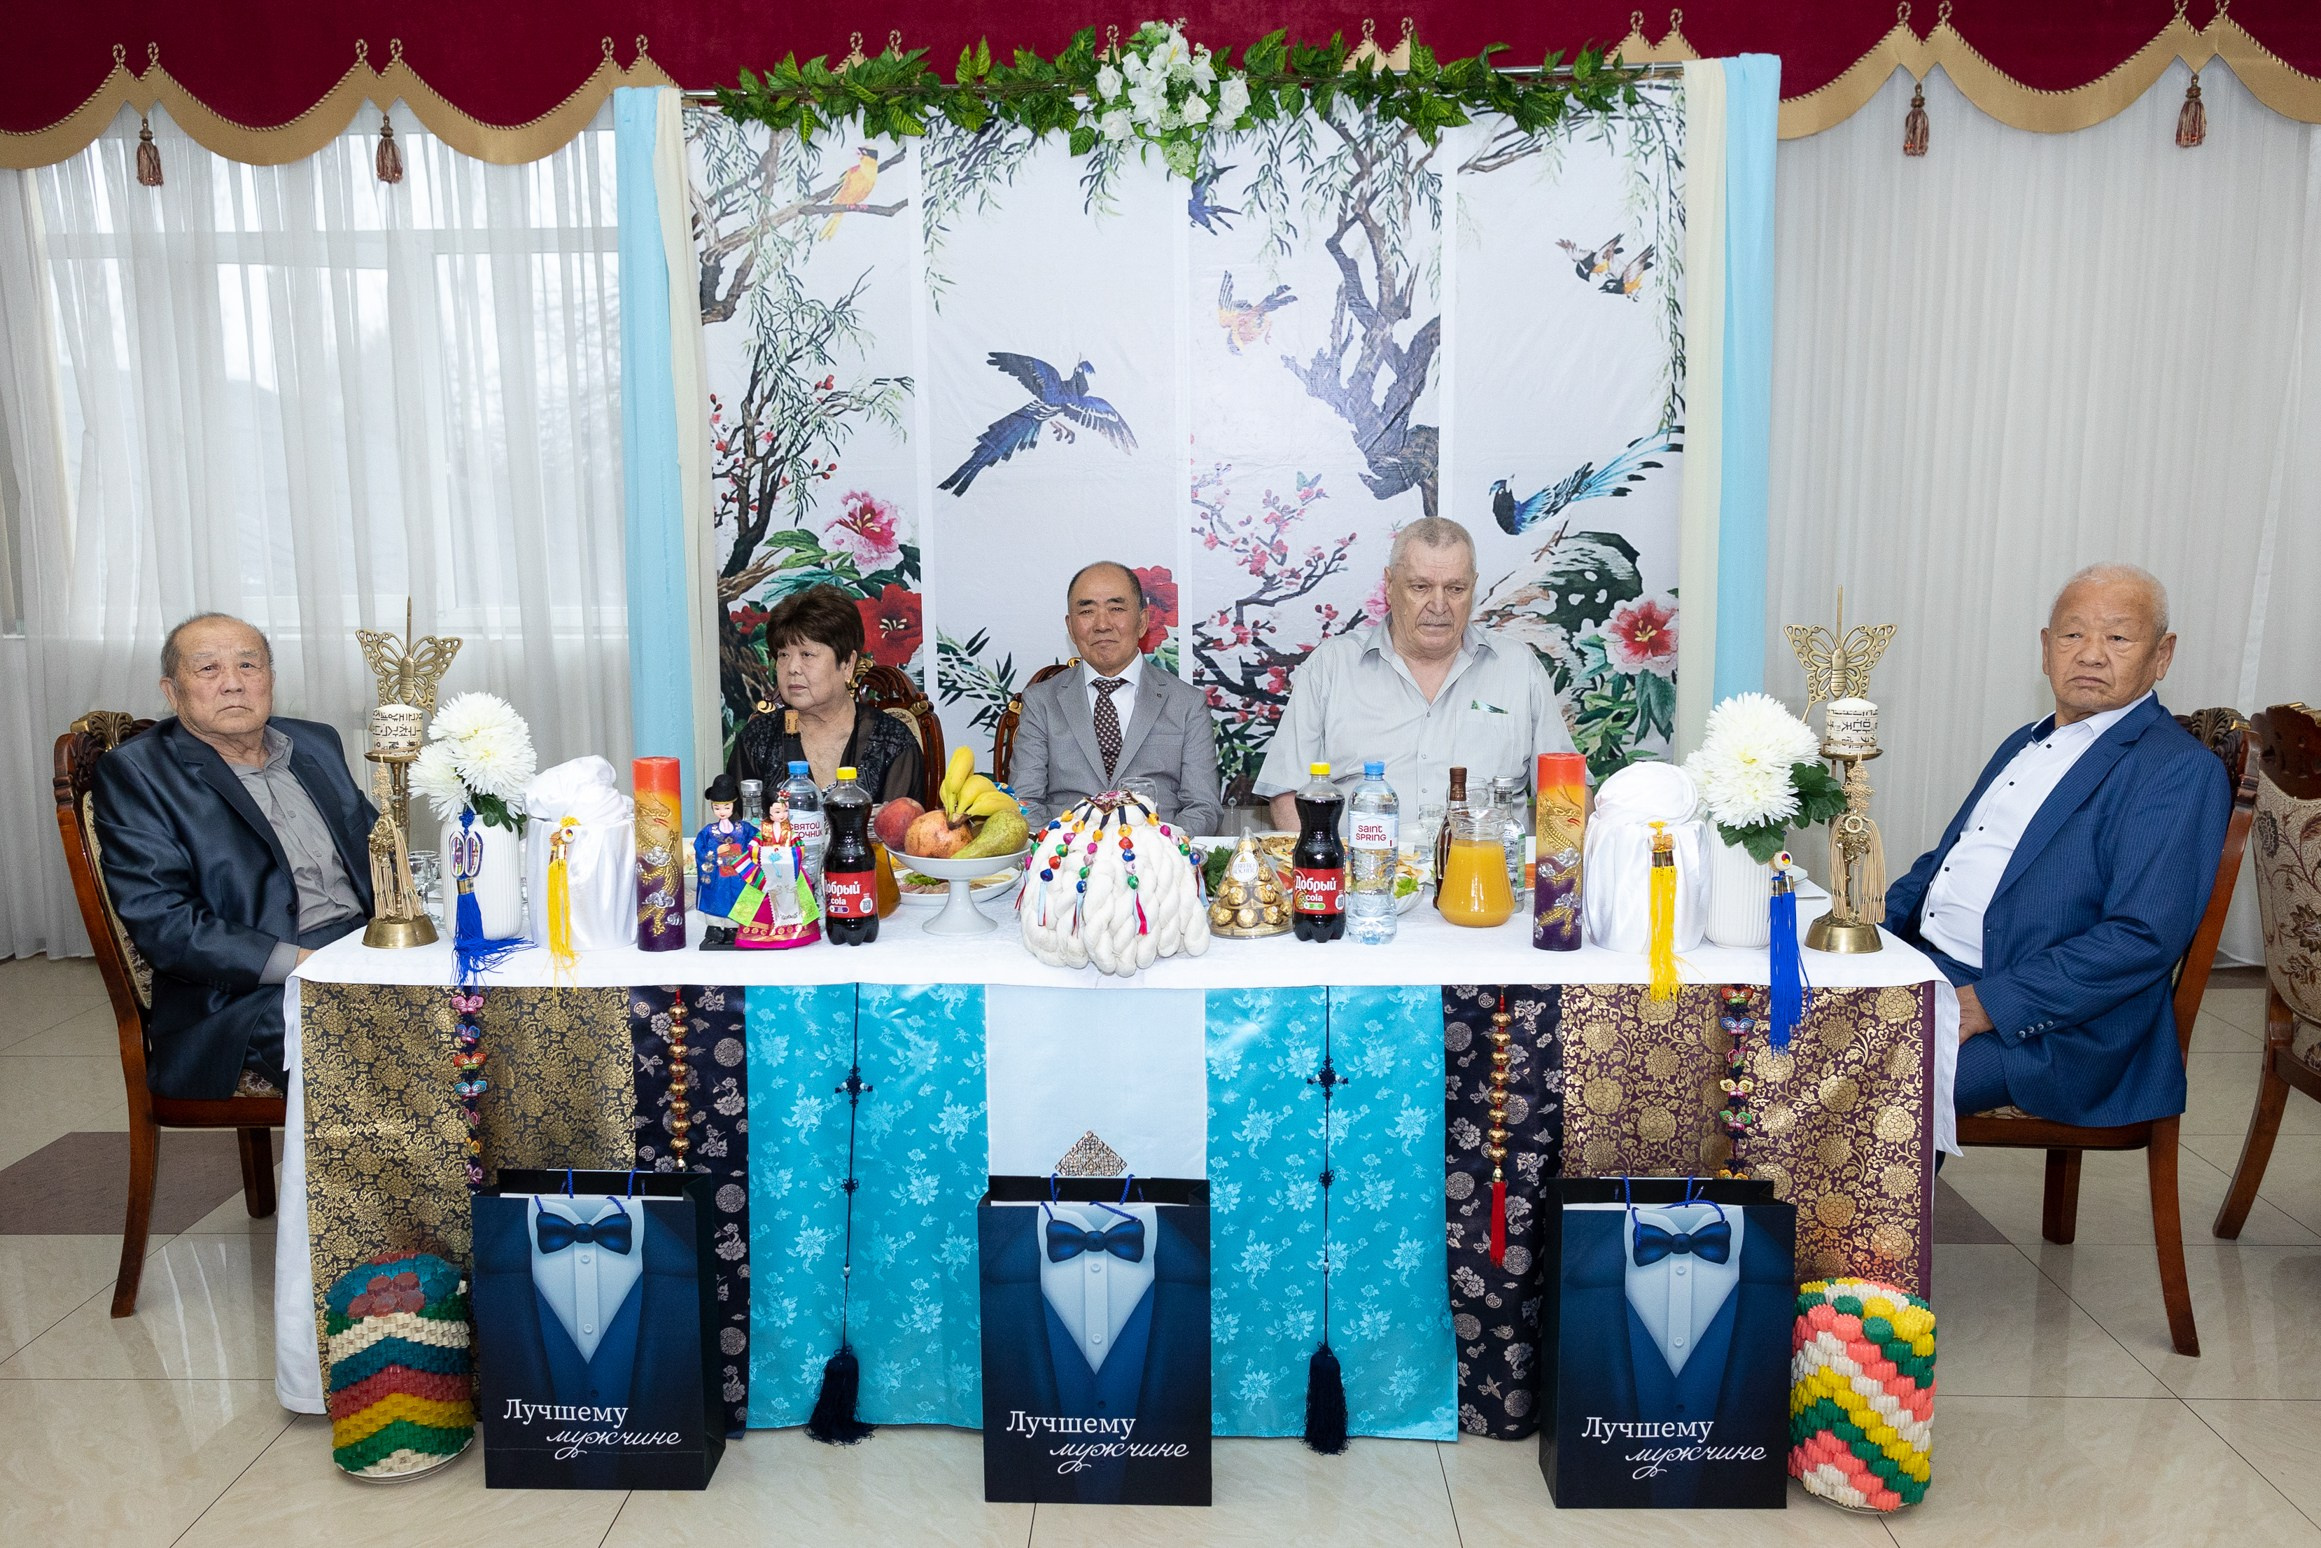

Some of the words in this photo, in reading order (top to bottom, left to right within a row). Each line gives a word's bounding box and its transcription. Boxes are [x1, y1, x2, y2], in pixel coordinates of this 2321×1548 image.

[1295, 875, 1337, 893] Добрый
[1305, 893, 1324, 902] cola
[830, 897, 847, 905] cola
[503, 1398, 629, 1429] Лучшему
[1006, 1410, 1137, 1441] Лучшему
[546, 1430, 682, 1460] мужчине
[1581, 1416, 1715, 1445] Лучшему
[1049, 1442, 1190, 1475] мужчине
[1624, 1445, 1767, 1480] мужчине
